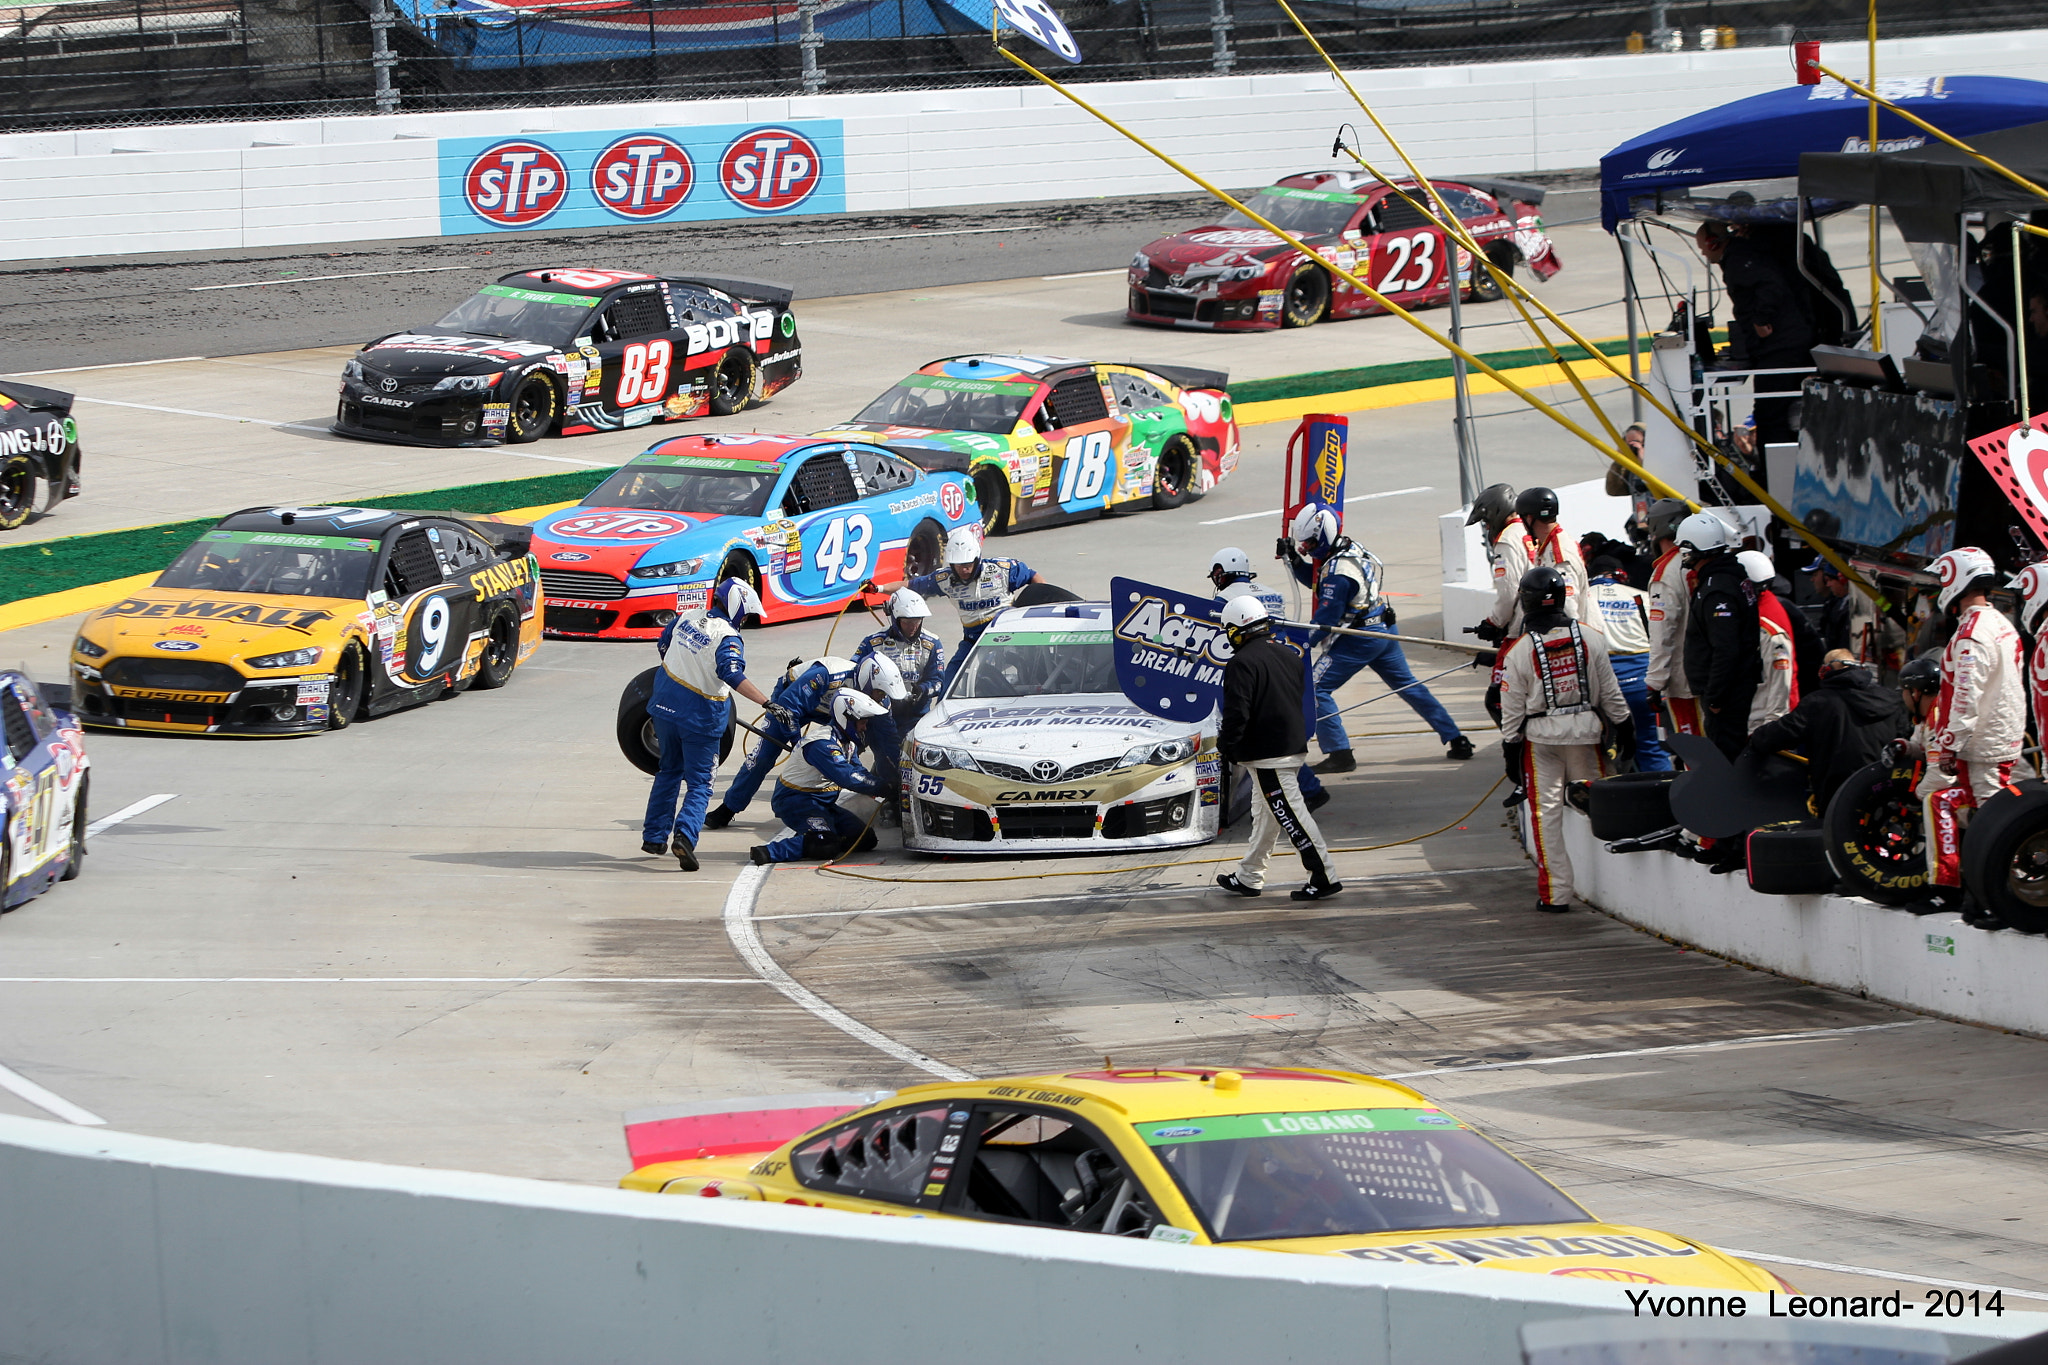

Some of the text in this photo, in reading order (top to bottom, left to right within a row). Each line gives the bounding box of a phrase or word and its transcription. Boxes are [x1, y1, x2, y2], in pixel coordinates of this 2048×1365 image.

[604, 145, 684, 206] STP
[731, 139, 809, 200] STP
[477, 151, 556, 214] STP
[1377, 232, 1436, 294] 23
[617, 341, 671, 405] 83
[931, 379, 996, 391] KYLE BUSCH
[361, 395, 415, 408] CAMRY
[482, 402, 511, 410] MOOG
[484, 409, 510, 418] MAHLE
[672, 457, 738, 469] ALMIROLA
[1058, 431, 1112, 503] 18
[1323, 432, 1341, 501] SUNOCO
[889, 502, 902, 515] The
[901, 498, 922, 512] Racer's
[941, 485, 963, 517] STP
[560, 514, 674, 535] STP
[250, 534, 326, 546] AMBROSE
[815, 513, 873, 587] 43
[557, 552, 585, 561] Ford
[469, 557, 532, 603] STANLEY
[677, 592, 707, 602] MAHLE
[677, 603, 699, 611] COMP
[958, 596, 1001, 611] Aaron's
[100, 599, 334, 629] DEWALT
[417, 595, 451, 672] 9
[1049, 633, 1113, 644] VICKER
[1119, 599, 1233, 662] Aaro
[157, 640, 196, 651] Ford
[1130, 649, 1225, 688] DREAM MA
[118, 689, 229, 703] FUSION
[297, 685, 330, 695] MAHLE
[934, 705, 1152, 728] Aaron
[959, 715, 1160, 733] DREAM MACHINE
[917, 774, 946, 796] 55
[995, 788, 1097, 801] CAMRY
[1272, 799, 1302, 838] Sprint
[1843, 841, 1929, 889] OODYEAR
[987, 1086, 1086, 1106] JOEY LOGANO
[1161, 1127, 1195, 1137] Ford
[1262, 1114, 1376, 1134] LOGANO
[1343, 1229, 1700, 1265] PENNZOIL
